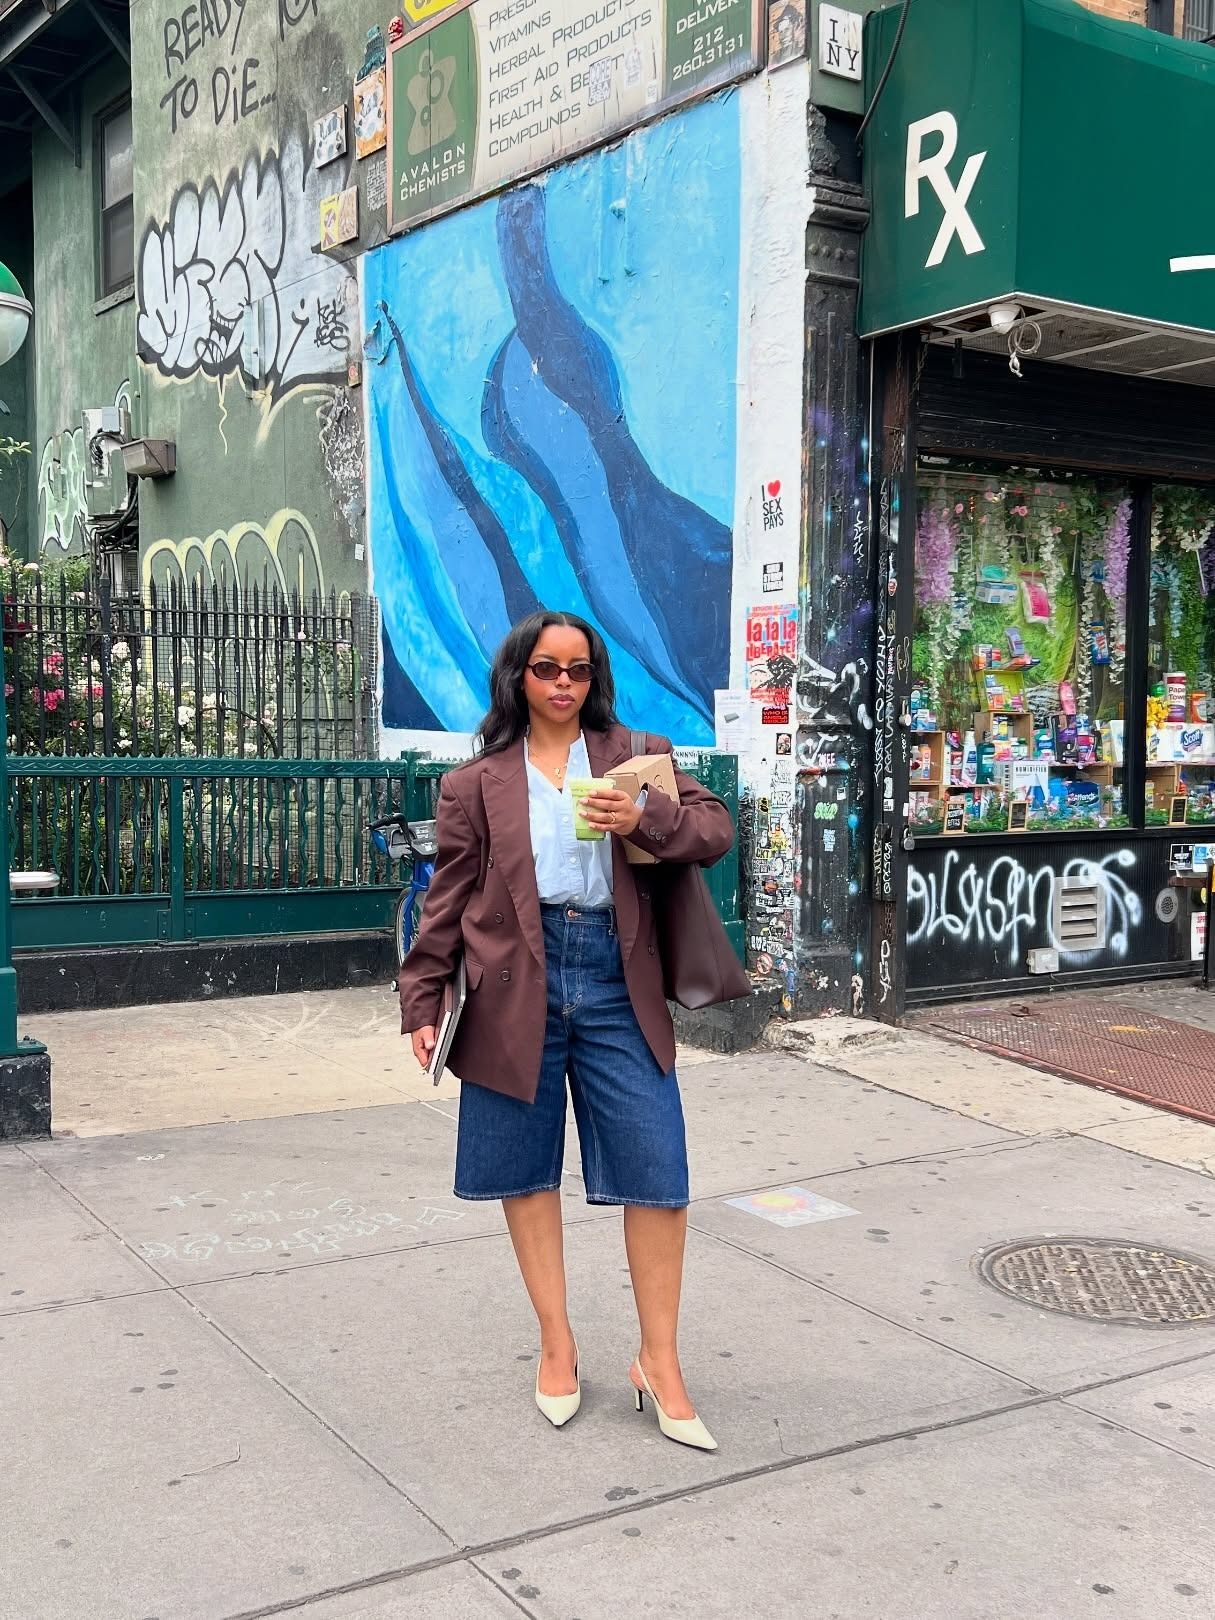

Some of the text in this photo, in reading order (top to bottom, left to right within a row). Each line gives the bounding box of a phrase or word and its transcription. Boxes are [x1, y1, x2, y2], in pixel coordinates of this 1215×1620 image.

[164, 0, 247, 79] READY
[489, 10, 551, 54] VITAMINS
[693, 26, 724, 54] 212
[829, 18, 839, 43] I
[489, 77, 528, 109] FIRST
[534, 61, 559, 87] AID
[567, 9, 652, 68] PRODUCTS
[489, 43, 546, 83] HERBAL
[672, 34, 744, 81] 260.3131
[826, 42, 860, 72] NY
[160, 75, 199, 135] TO
[489, 96, 543, 133] HEALTH
[550, 85, 562, 103] &
[489, 102, 581, 158] COMPOUNDS
[400, 142, 466, 186] AVALON
[400, 160, 466, 201] CHEMISTS
[761, 485, 766, 502] I
[762, 497, 782, 517] SEX
[763, 512, 784, 532] PAYS
[1183, 729, 1201, 746] Scott
